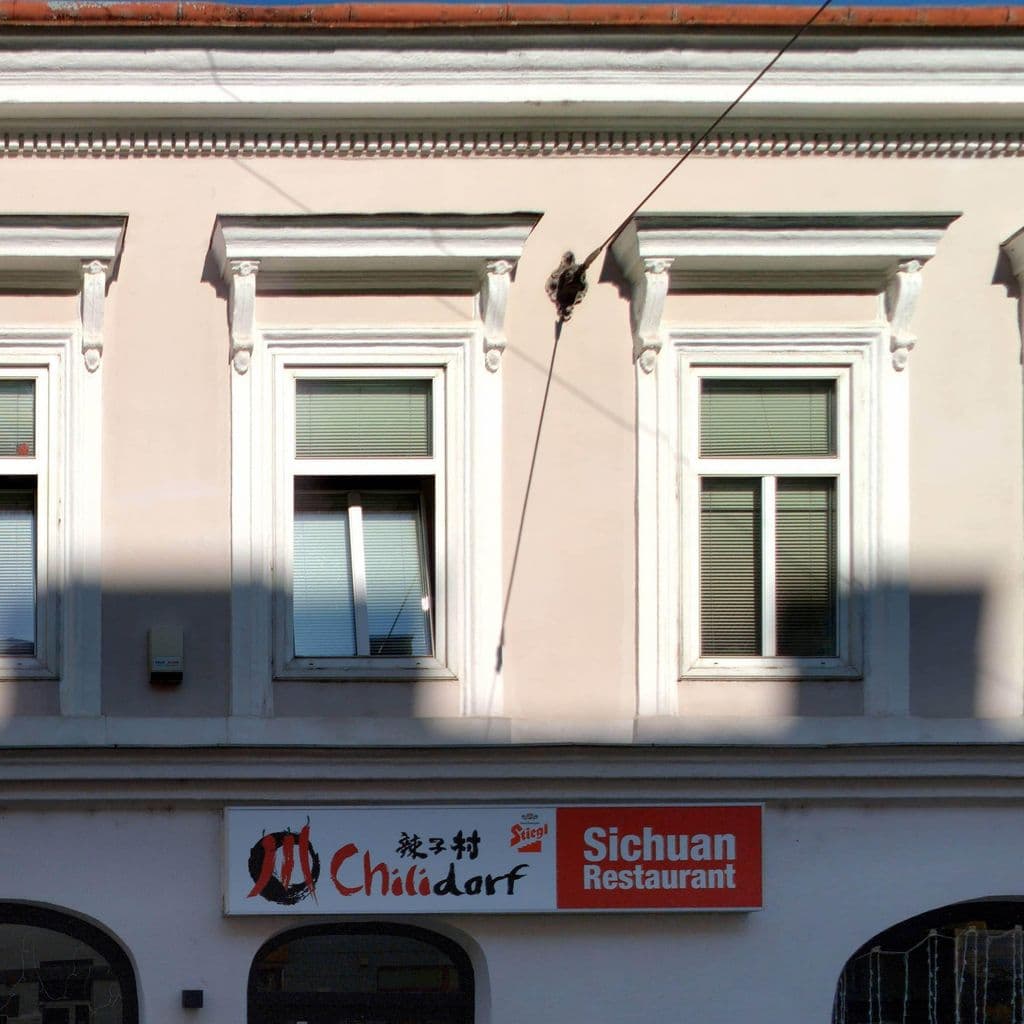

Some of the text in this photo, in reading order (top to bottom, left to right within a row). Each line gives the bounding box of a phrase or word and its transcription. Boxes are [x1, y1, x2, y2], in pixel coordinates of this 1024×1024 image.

[396, 829, 482, 861] 辣子村
[583, 826, 737, 862] Sichuan
[329, 841, 529, 898] Chilidorf
[583, 863, 737, 891] Restaurant
